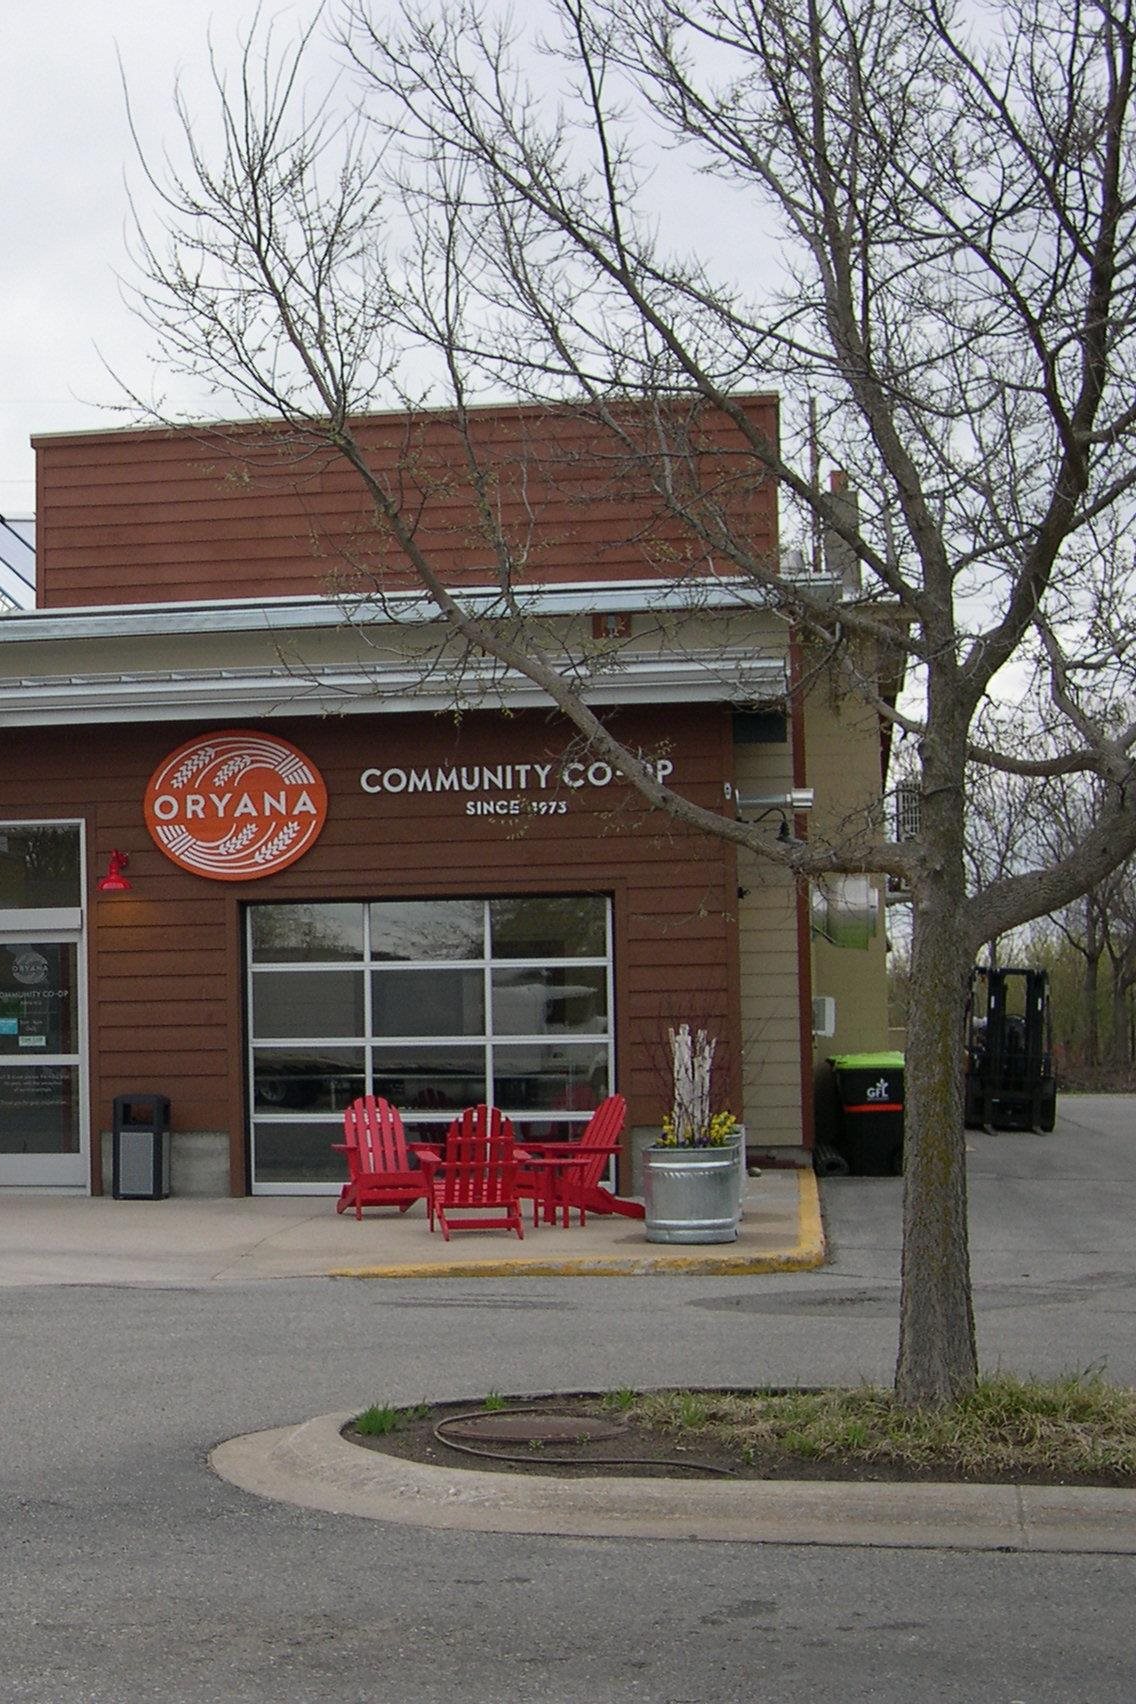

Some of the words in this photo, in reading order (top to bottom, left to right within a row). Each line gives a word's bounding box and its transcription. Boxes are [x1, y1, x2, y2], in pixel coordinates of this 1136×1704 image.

[360, 763, 552, 793] COMMUNITY
[563, 759, 674, 788] CO-P
[154, 790, 317, 820] ORYANA
[465, 800, 520, 815] SINCE
[530, 800, 568, 815] 1973
